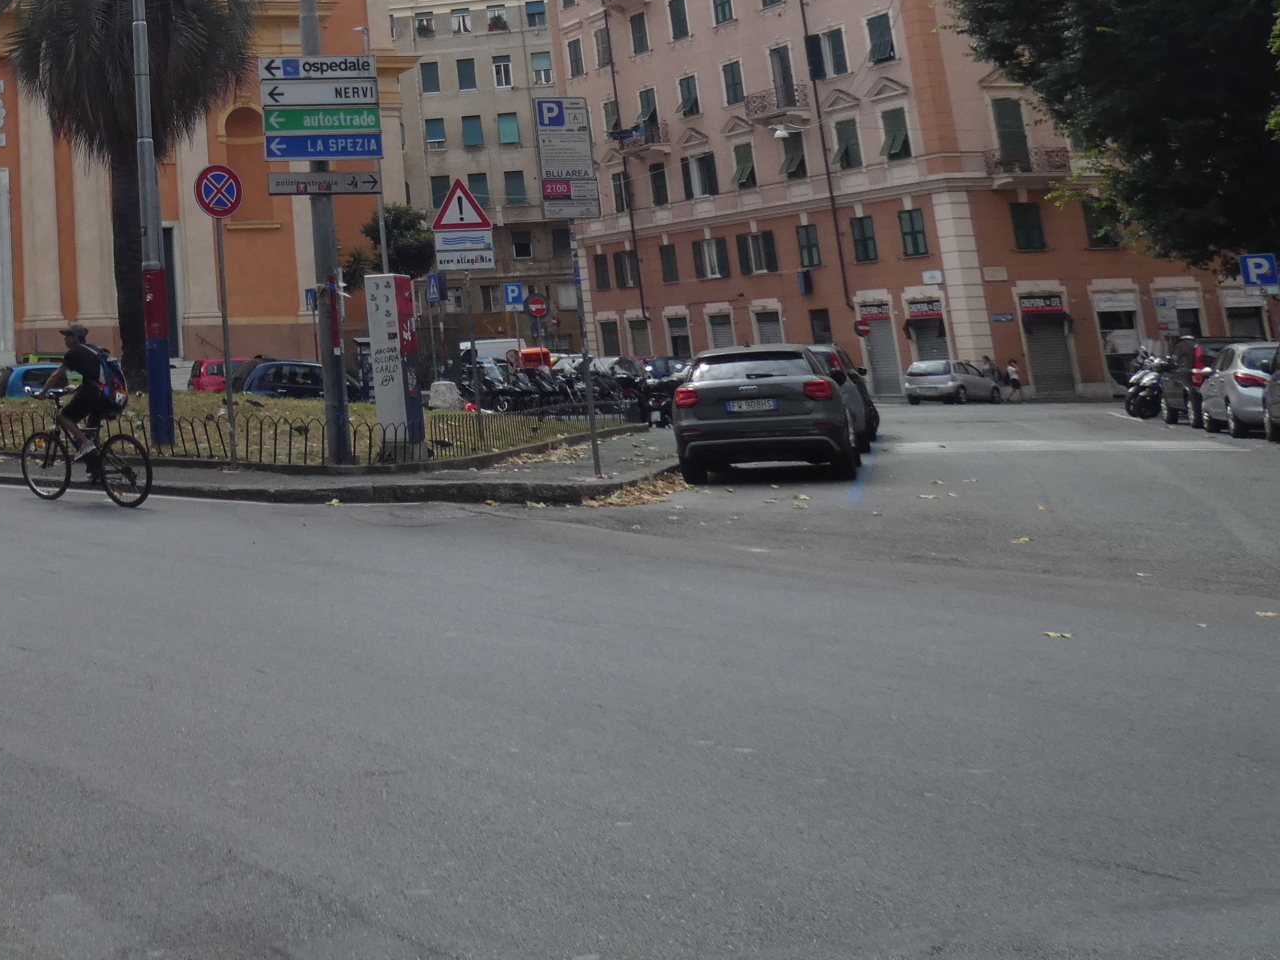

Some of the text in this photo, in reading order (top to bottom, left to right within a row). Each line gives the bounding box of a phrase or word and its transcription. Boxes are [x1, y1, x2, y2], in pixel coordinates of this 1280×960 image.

[302, 58, 371, 75] ospedale
[334, 86, 374, 99] NERVI
[302, 110, 376, 127] autostrade
[541, 102, 559, 125] P
[572, 114, 579, 122] A
[307, 138, 378, 152] LA SPEZIA
[545, 170, 563, 178] BLU
[546, 184, 568, 193] 2100
[1246, 258, 1269, 284] P
[507, 285, 519, 303] P
[375, 364, 398, 374] CARLO
